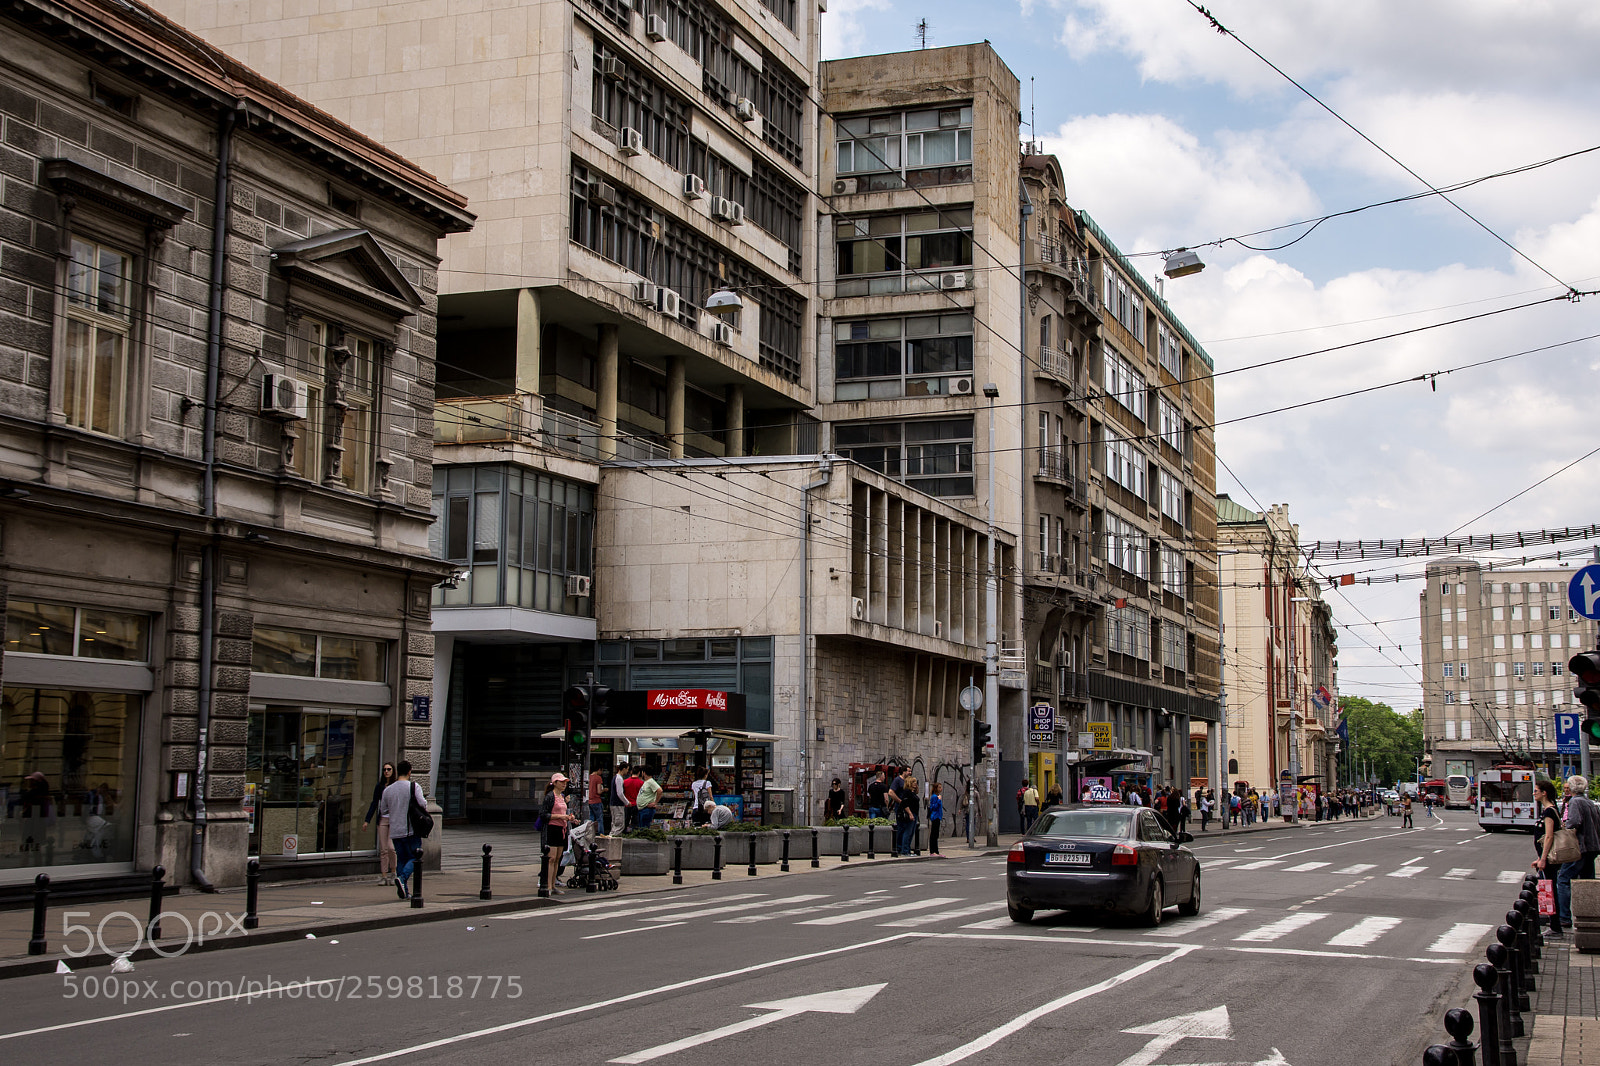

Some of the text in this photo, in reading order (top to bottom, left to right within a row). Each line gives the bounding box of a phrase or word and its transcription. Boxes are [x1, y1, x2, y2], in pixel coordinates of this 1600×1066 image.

[1560, 716, 1574, 734] P
[1091, 790, 1111, 799] TAXI
[1050, 853, 1059, 862] BG
